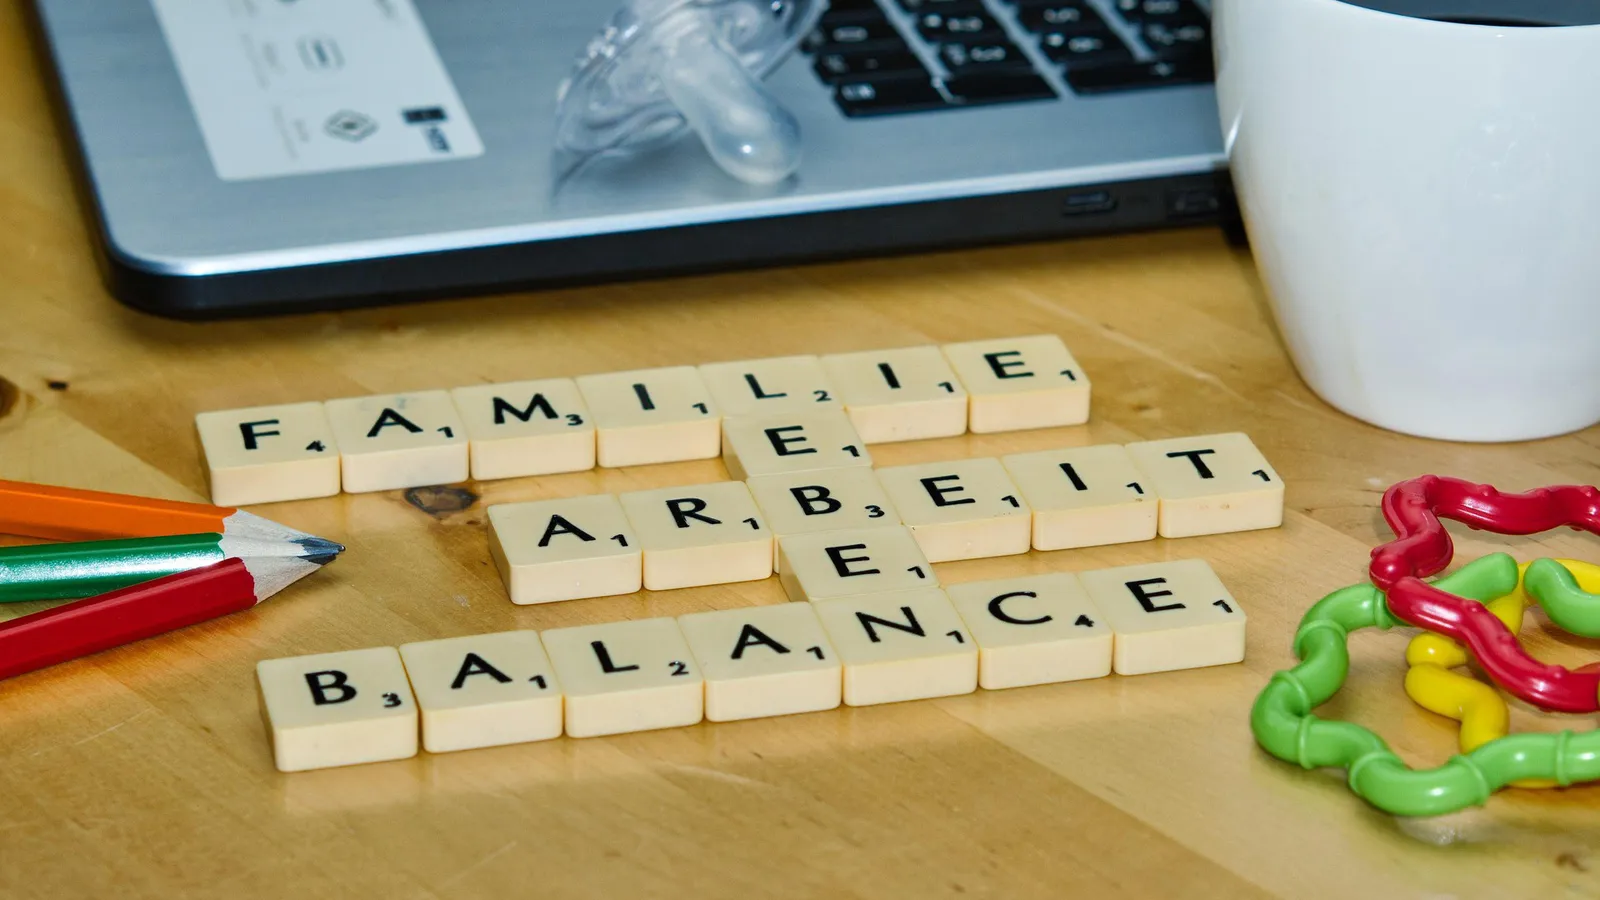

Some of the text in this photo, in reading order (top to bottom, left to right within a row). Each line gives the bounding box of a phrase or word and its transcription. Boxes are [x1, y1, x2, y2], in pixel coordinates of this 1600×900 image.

[238, 350, 1035, 451] FAMILIE
[305, 369, 1076, 453] 4 1 3 1 2 1 1
[841, 444, 861, 458] 1
[537, 448, 1216, 548] ARBEIT
[610, 469, 1271, 548] 1 1 3 1 1 1
[907, 565, 926, 579] 1
[303, 577, 1187, 706] BALANCE
[381, 599, 1234, 709] 3 1 2 1 1 4 1
